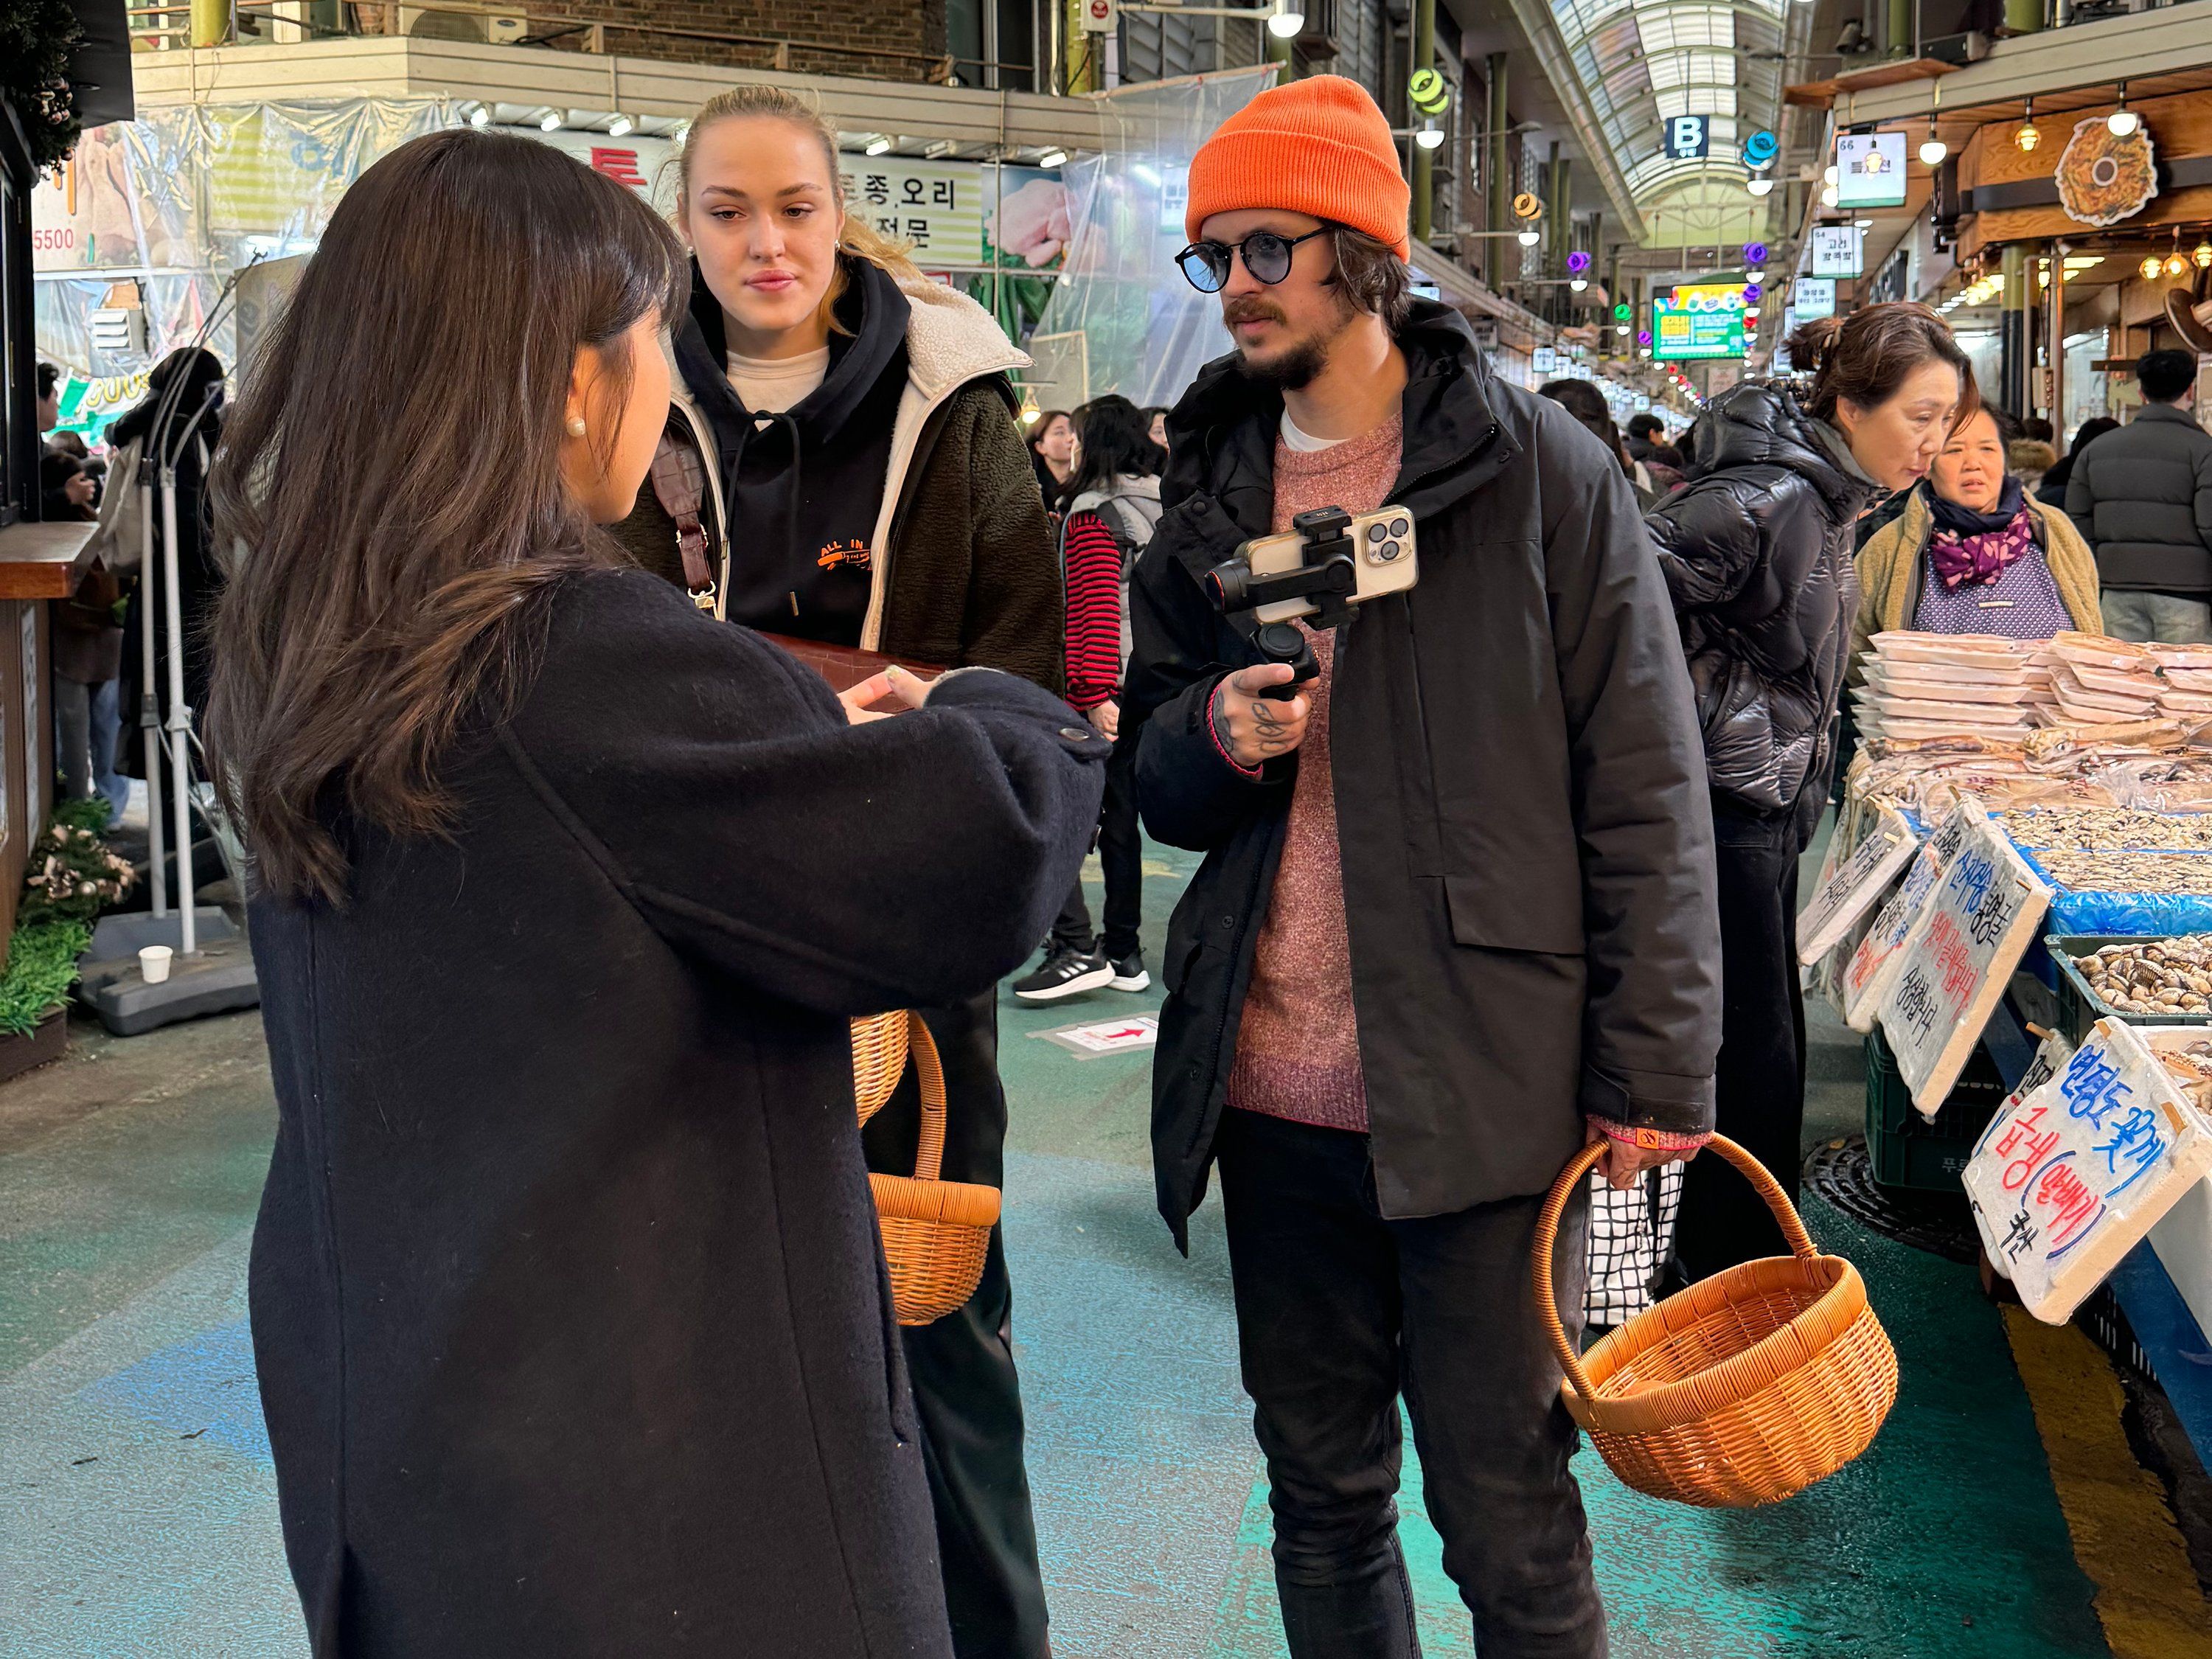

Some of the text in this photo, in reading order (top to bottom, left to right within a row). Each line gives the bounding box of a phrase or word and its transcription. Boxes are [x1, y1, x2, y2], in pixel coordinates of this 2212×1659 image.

[1673, 116, 1703, 150] B
[1839, 140, 1854, 150] 66
[821, 539, 863, 557] ALL IN
[1970, 880, 2012, 948] 통영굴
[2060, 1043, 2166, 1199] 연평도 꽃게
[1999, 1208, 2039, 1265] 국산
